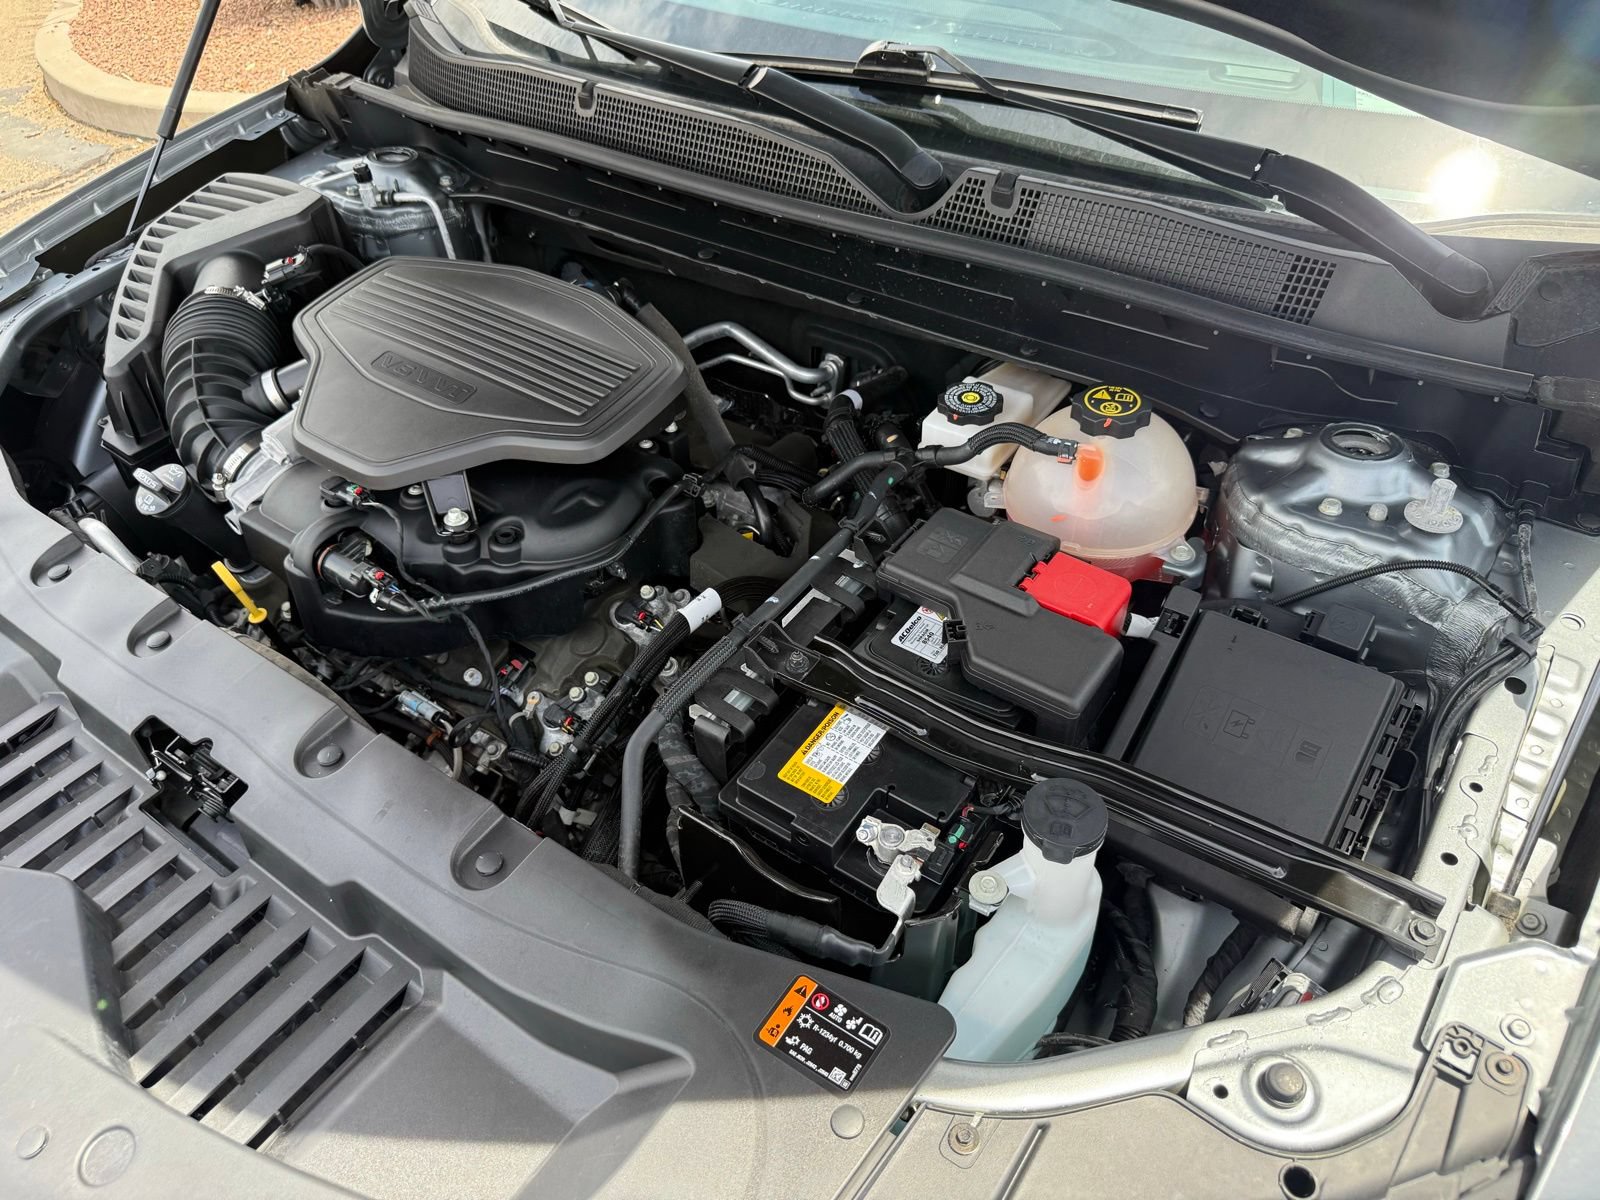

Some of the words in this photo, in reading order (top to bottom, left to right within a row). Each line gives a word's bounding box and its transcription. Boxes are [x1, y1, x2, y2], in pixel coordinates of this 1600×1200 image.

[898, 615, 922, 642] ACDelco
[828, 1012, 843, 1023] AUTO
[799, 1043, 813, 1055] PAG
[812, 1023, 838, 1043] R-1234yf
[838, 1040, 855, 1054] 0.700
[853, 1049, 863, 1060] kg
